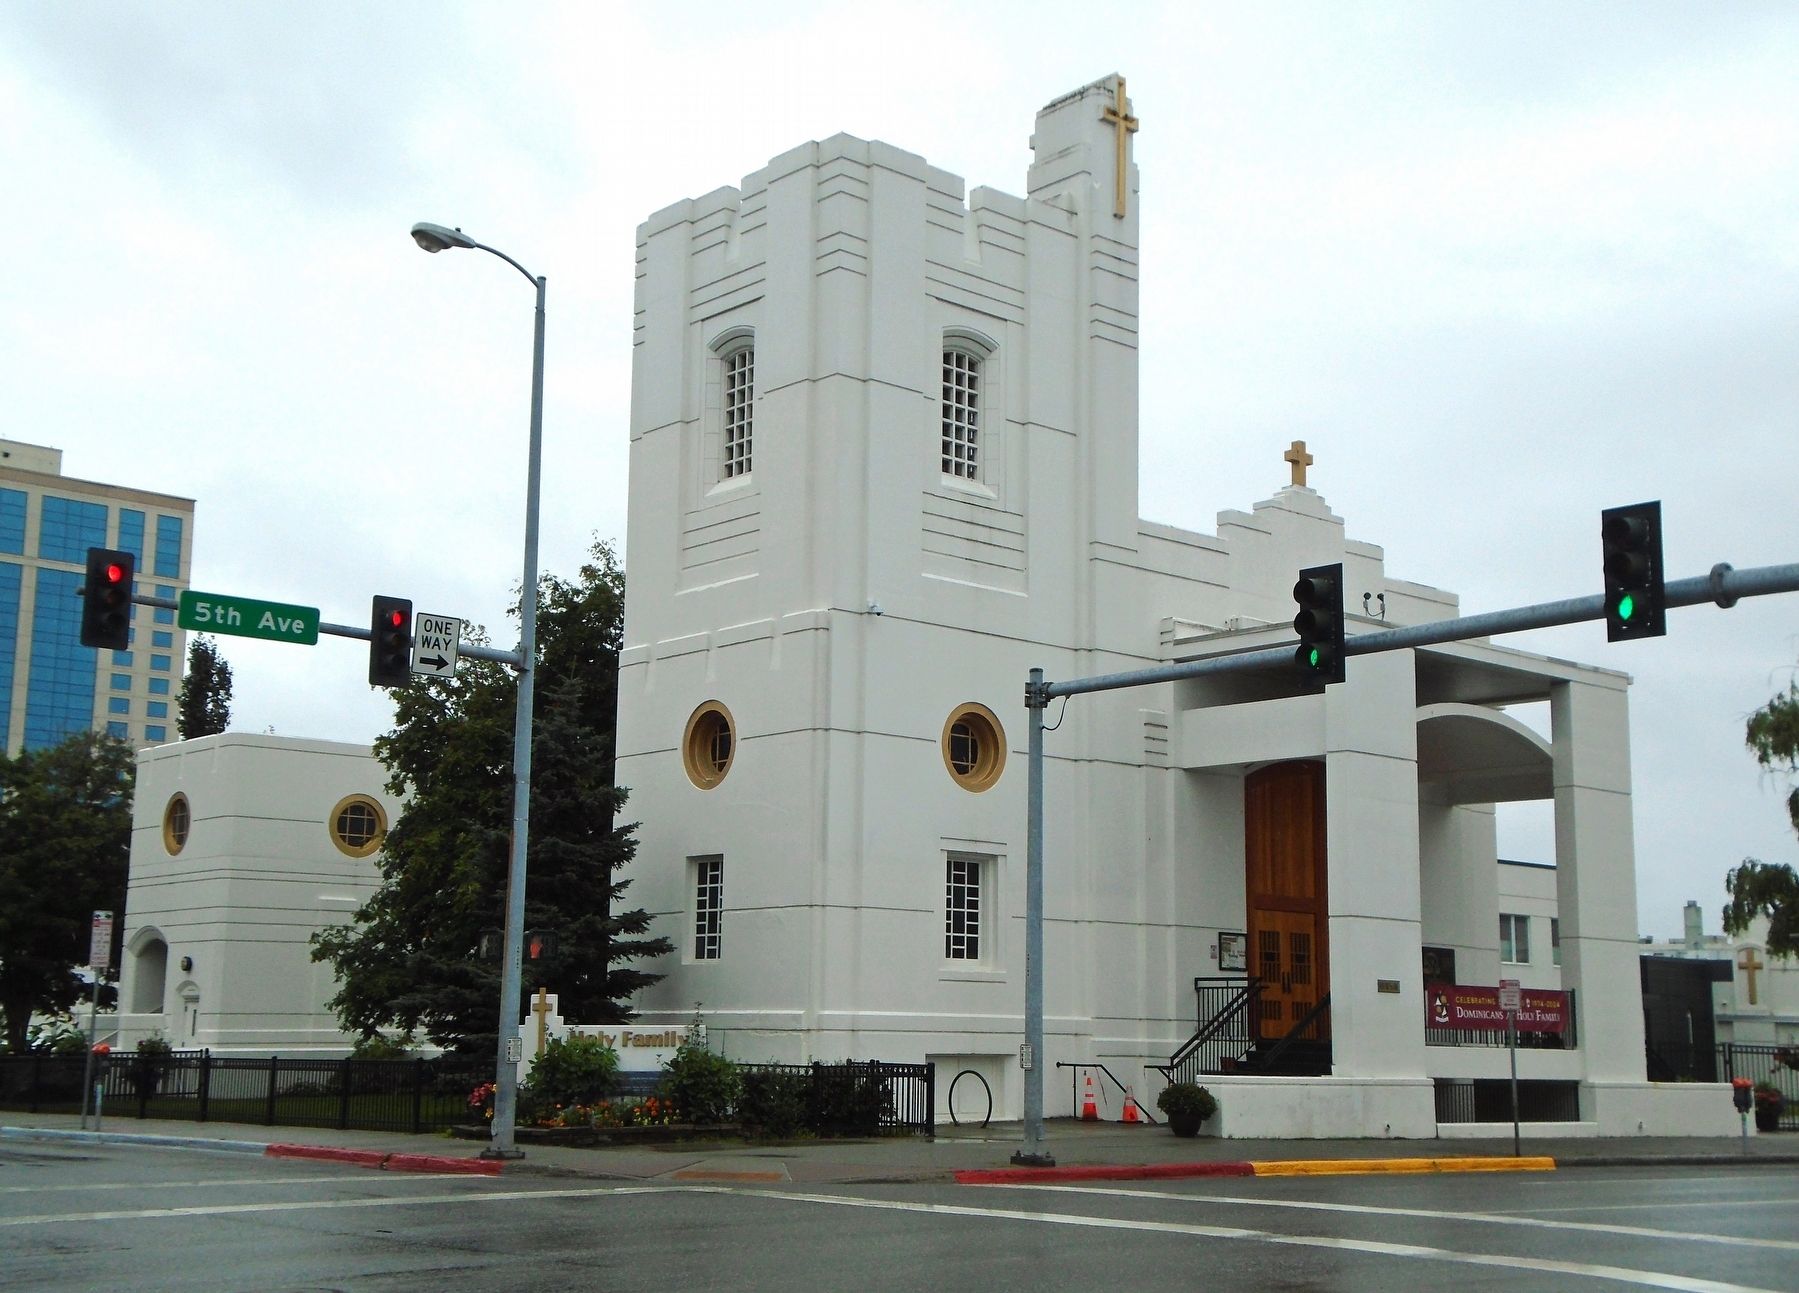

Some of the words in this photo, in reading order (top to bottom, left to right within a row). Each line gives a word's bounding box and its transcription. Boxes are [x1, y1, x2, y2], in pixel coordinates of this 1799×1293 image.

[194, 601, 241, 626] 5th
[257, 611, 305, 634] Ave
[424, 619, 453, 636] ONE
[421, 635, 452, 652] WAY
[1456, 996, 1496, 1006] CELEBRATING
[1456, 1006, 1503, 1020] DOMINICANS
[1516, 1009, 1534, 1021] HOLY
[1536, 1010, 1561, 1022] FAMILY
[622, 1031, 689, 1048] Family
